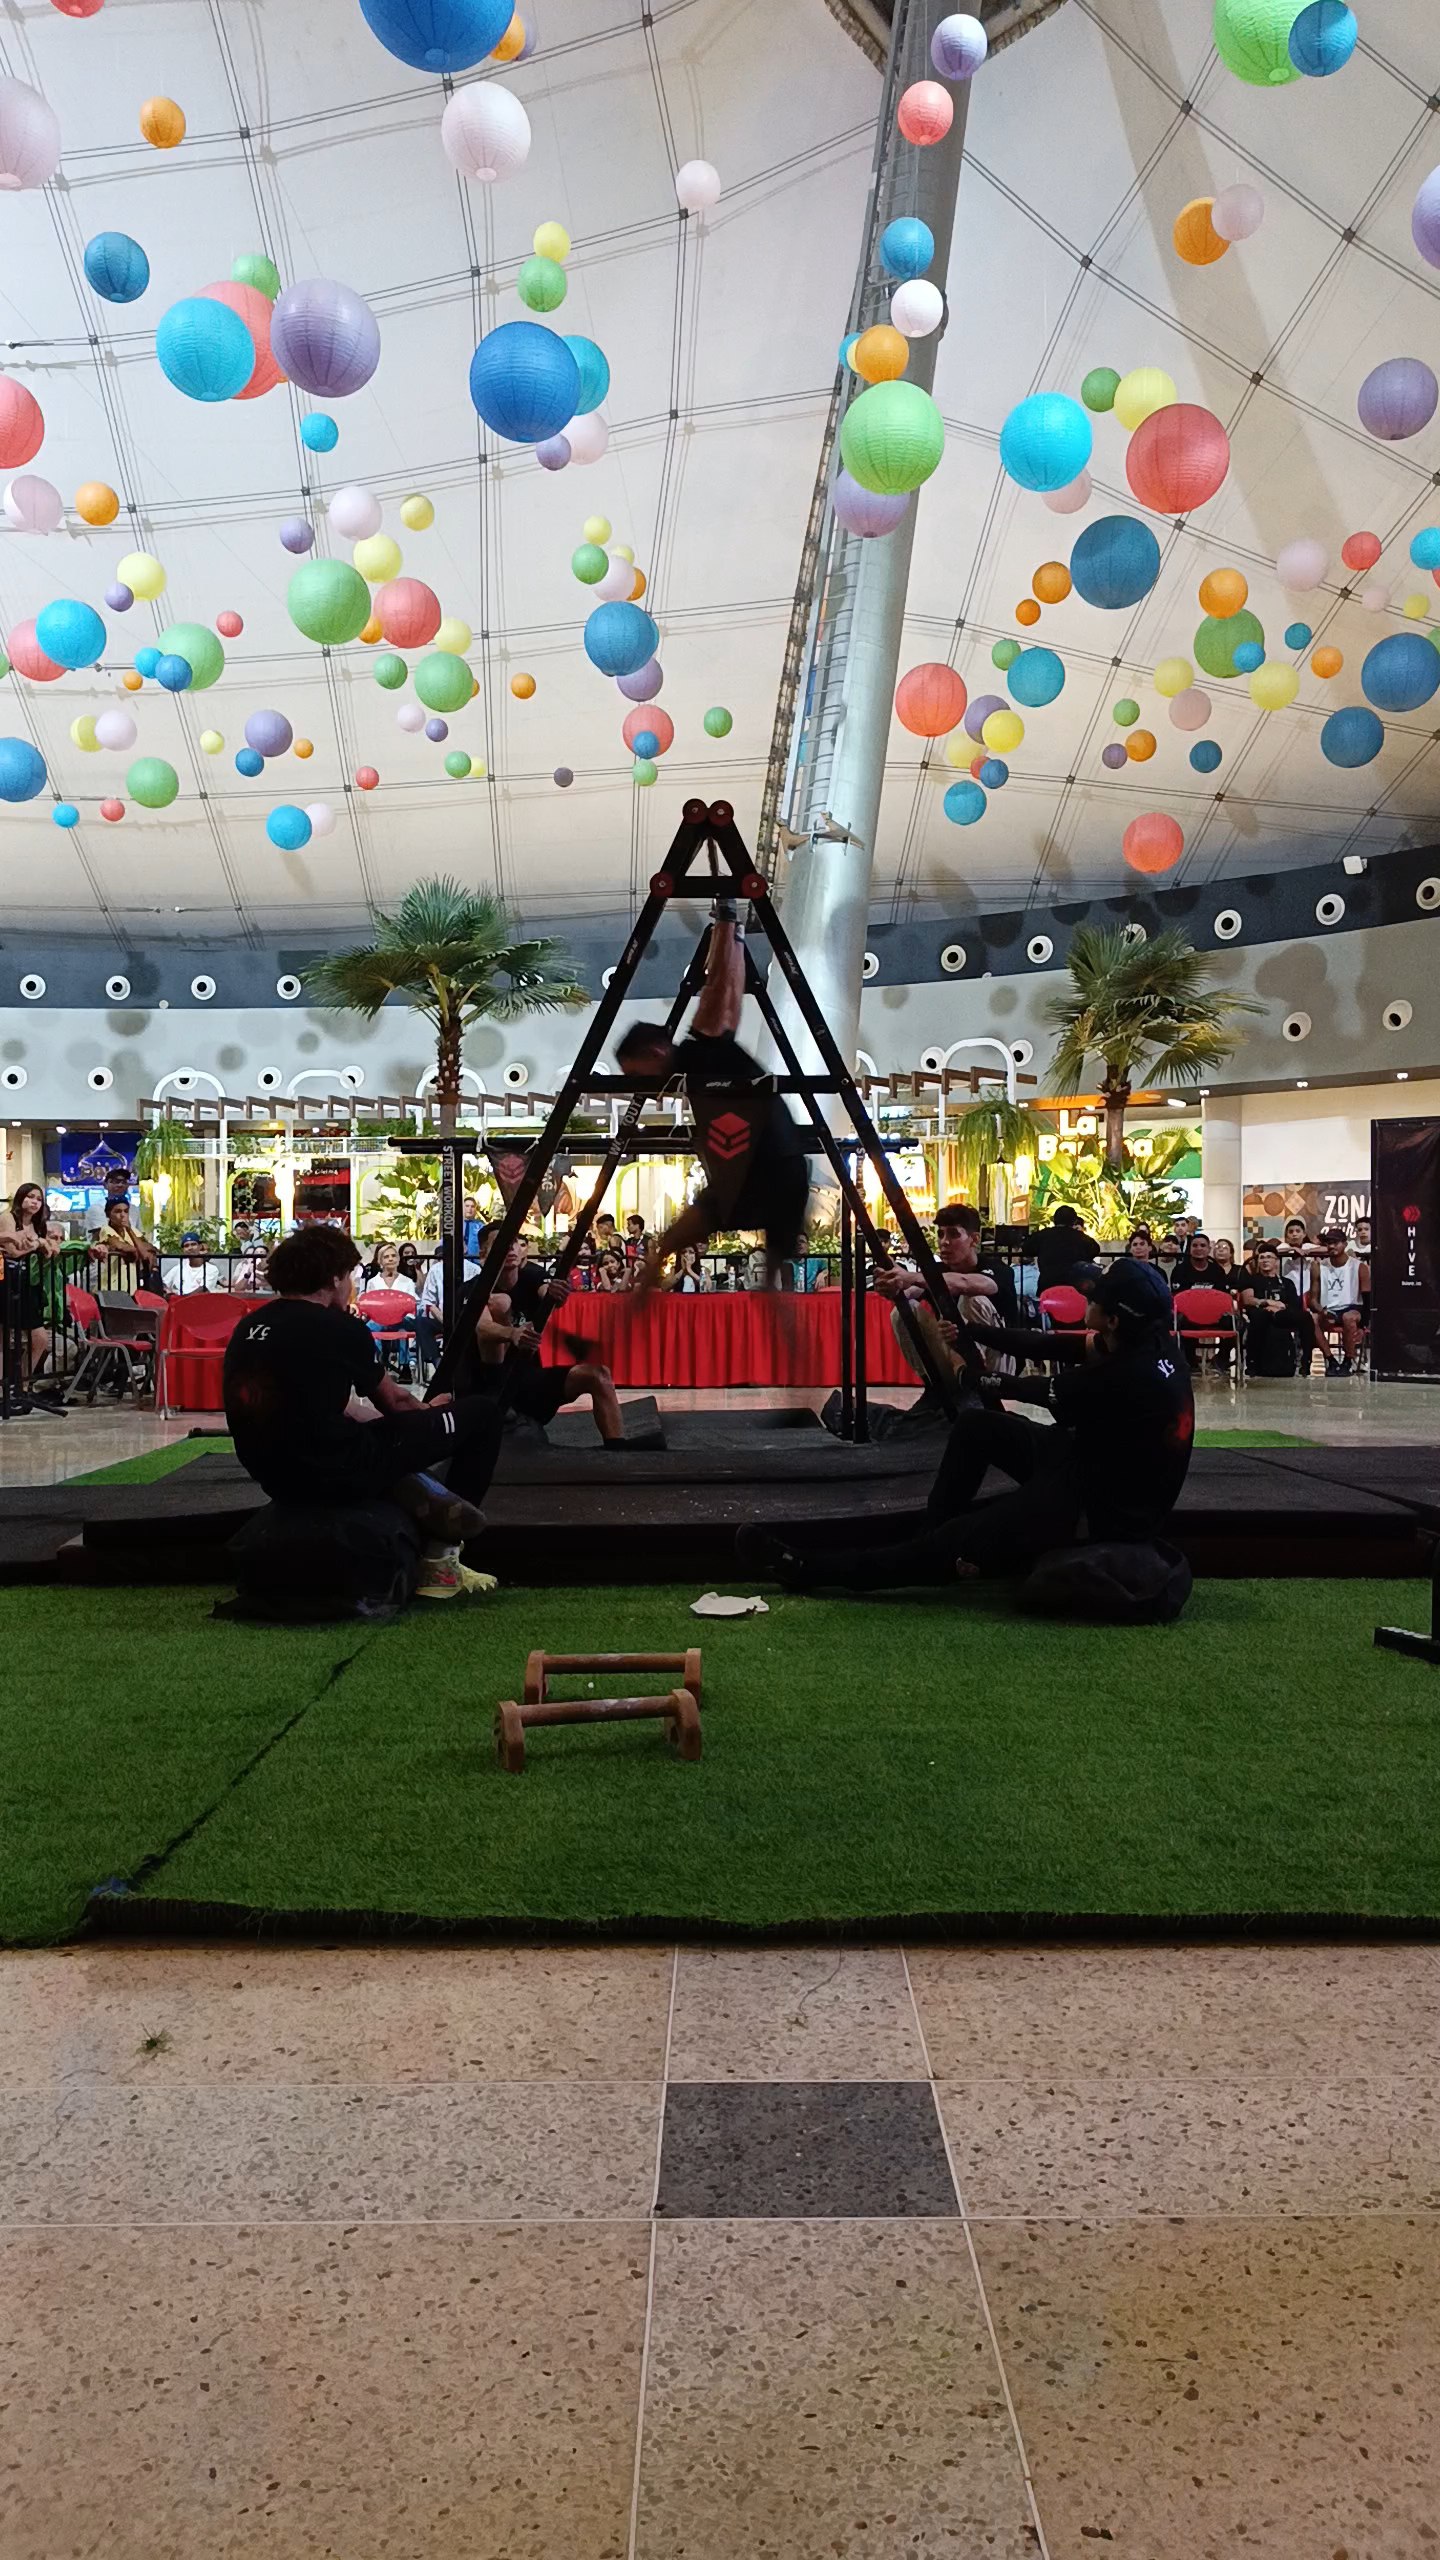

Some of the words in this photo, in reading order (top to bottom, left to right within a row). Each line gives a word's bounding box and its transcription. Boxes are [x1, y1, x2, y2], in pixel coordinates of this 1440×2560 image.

[1059, 1109, 1098, 1137] La
[442, 1145, 454, 1182] STREET
[443, 1185, 454, 1236] WORKOUT
[1407, 1226, 1416, 1276] HIVE
